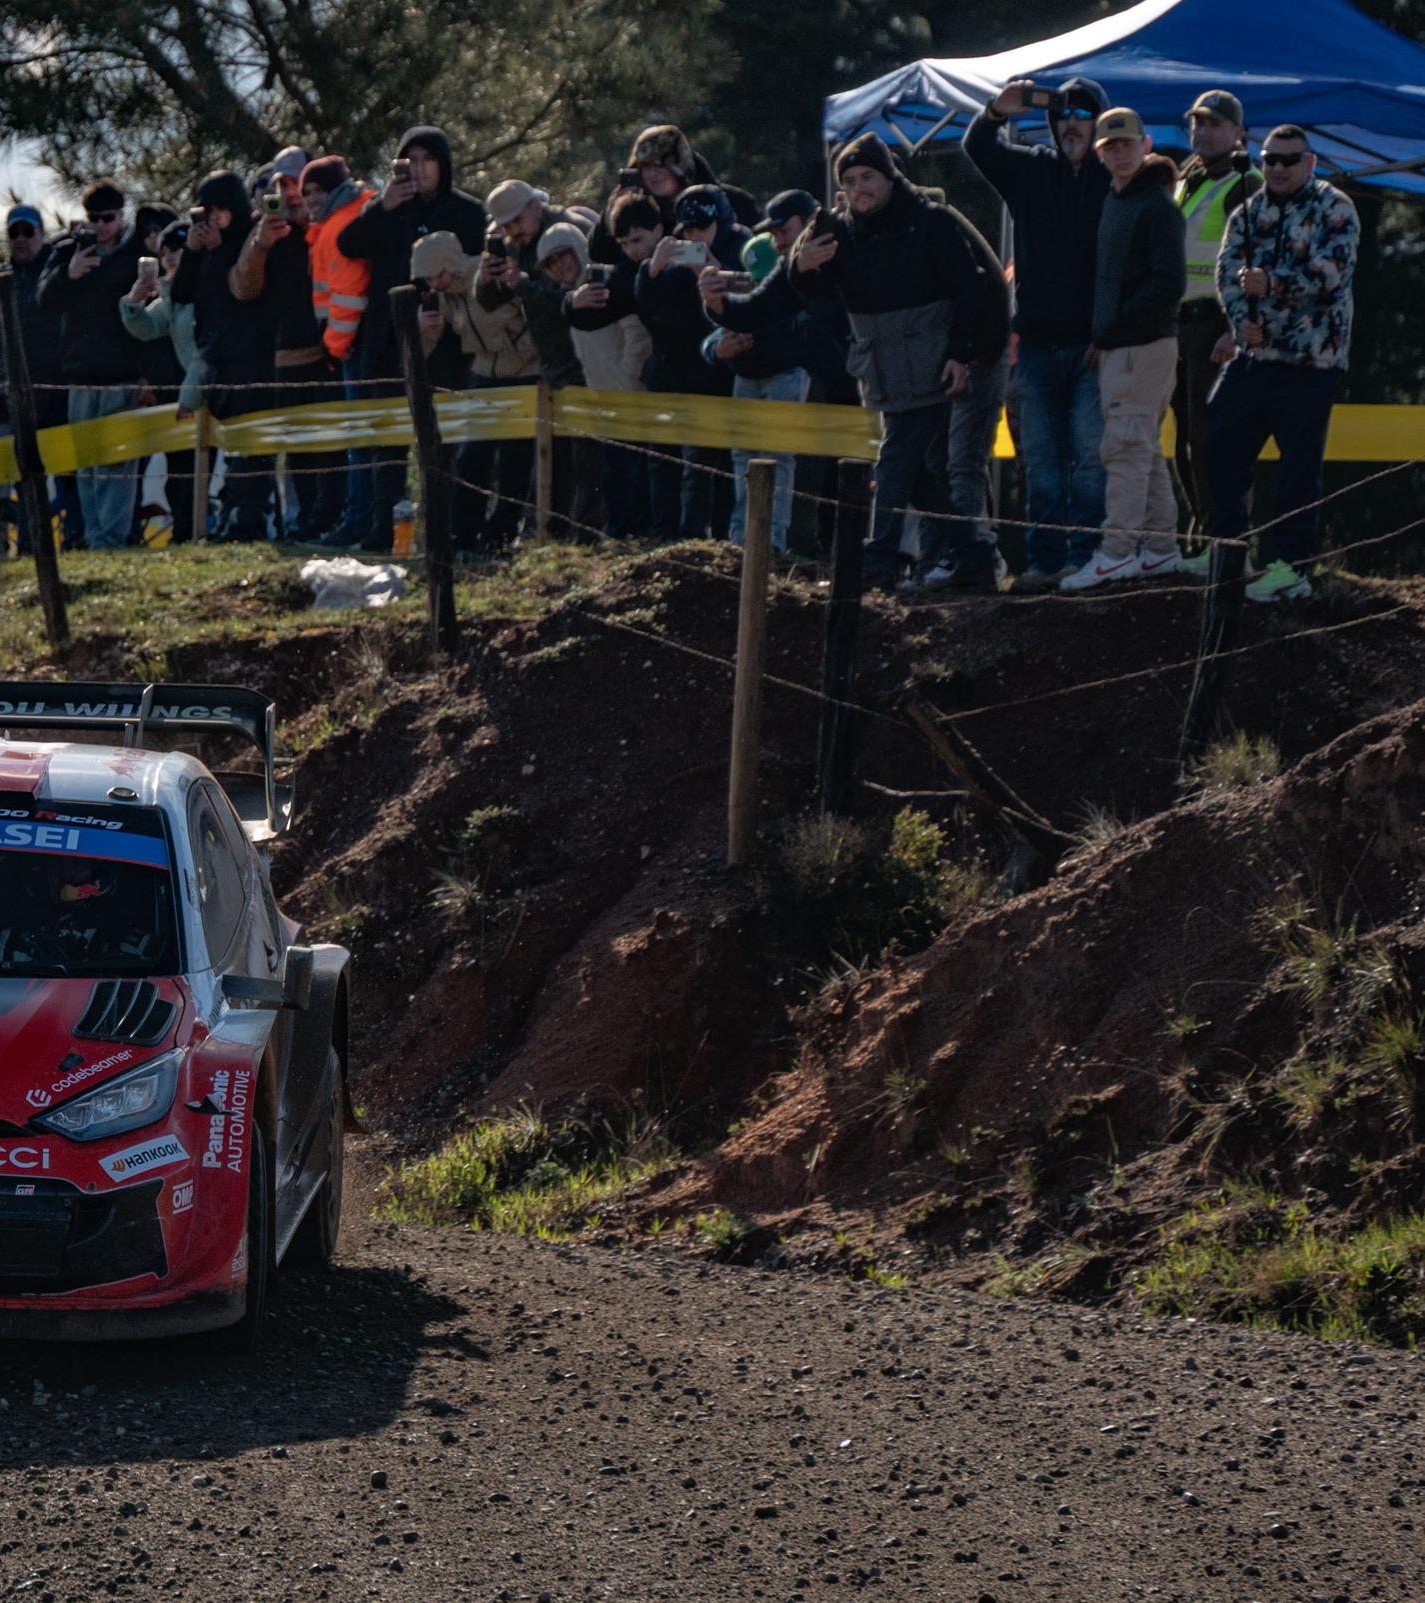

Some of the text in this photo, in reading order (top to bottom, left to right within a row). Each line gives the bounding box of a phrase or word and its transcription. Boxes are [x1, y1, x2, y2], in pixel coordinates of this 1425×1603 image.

[34, 810, 124, 830] Racing
[51, 1049, 133, 1093] codebeamer
[202, 1069, 230, 1169] Panaonic
[227, 1069, 251, 1173] AUTOMOTIVE
